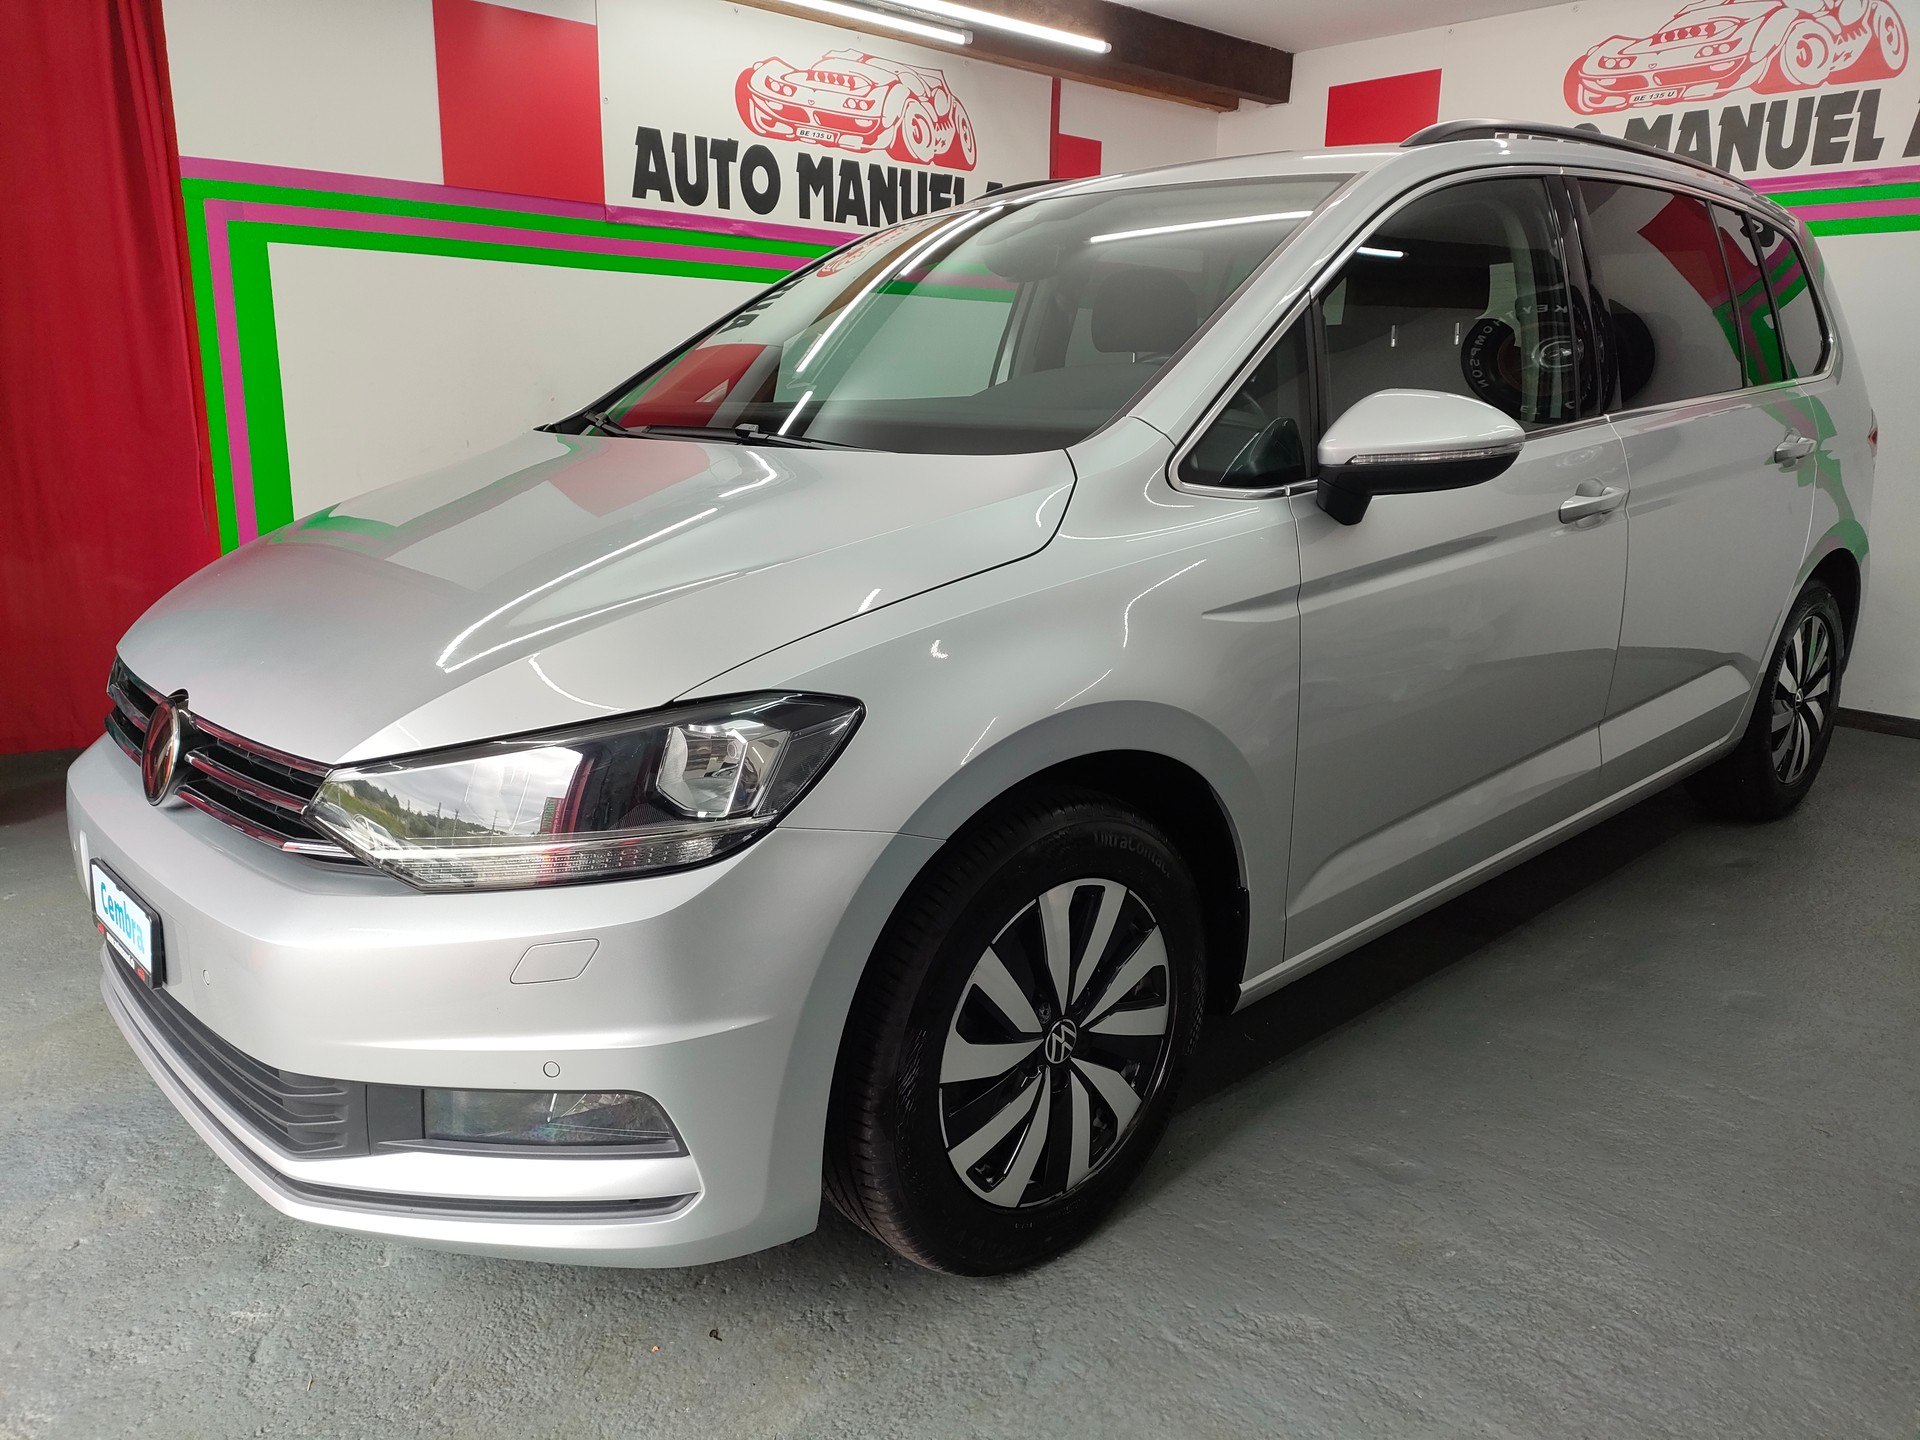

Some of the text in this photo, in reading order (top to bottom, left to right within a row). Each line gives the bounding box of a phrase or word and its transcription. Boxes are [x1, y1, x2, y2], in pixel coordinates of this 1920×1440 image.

[1633, 94, 1647, 102] BE
[1649, 91, 1666, 100] 135
[799, 129, 810, 137] BE
[812, 131, 825, 139] 135
[632, 126, 781, 215] AUTO
[100, 881, 145, 955] Cembra
